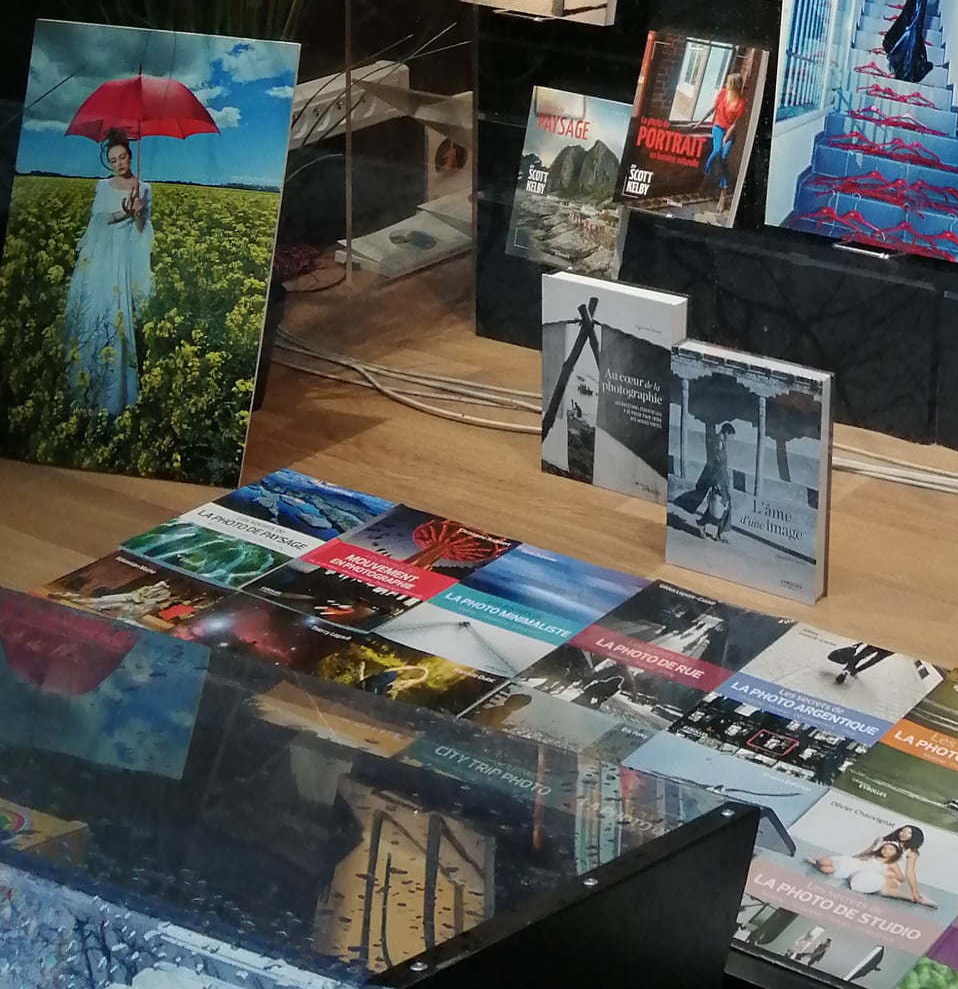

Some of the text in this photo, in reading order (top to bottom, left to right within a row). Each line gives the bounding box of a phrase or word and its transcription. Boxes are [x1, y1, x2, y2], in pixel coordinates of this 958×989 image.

[536, 112, 590, 140] PAYSAGE
[636, 126, 707, 158] PORTRAIT
[526, 180, 546, 194] KELBY
[528, 168, 549, 182] SCOTT
[626, 180, 650, 196] KELBY
[629, 168, 654, 184] SCOTT
[604, 368, 653, 389] Au cœur de
[602, 380, 663, 404] photographie
[753, 499, 792, 522] L'âme
[198, 510, 308, 550] LA PHOTO DE PAYSAGE
[766, 519, 803, 541] image
[329, 558, 346, 566] EN
[342, 562, 416, 590] PHOTOGRAPHIE
[344, 554, 420, 583] MOUVEMENT
[444, 592, 462, 603] LA
[460, 598, 501, 615] PHOTO
[498, 610, 572, 638] MINIMALISTE
[596, 638, 614, 650] LA
[613, 644, 658, 664] PHOTO
[657, 658, 678, 670] DE
[675, 664, 705, 680] RUE
[730, 681, 750, 694] LA
[749, 686, 796, 709] PHOTO
[793, 704, 880, 736] ARGENTIQUE
[778, 688, 845, 714] Les secrets de
[894, 730, 914, 745] LA
[930, 732, 954, 748] Les
[434, 745, 552, 796] CITY TRIP PHOTO
[753, 874, 777, 890] LA
[776, 882, 835, 911] PHOTO
[832, 902, 860, 920] DE
[856, 912, 922, 941] STUDIO
